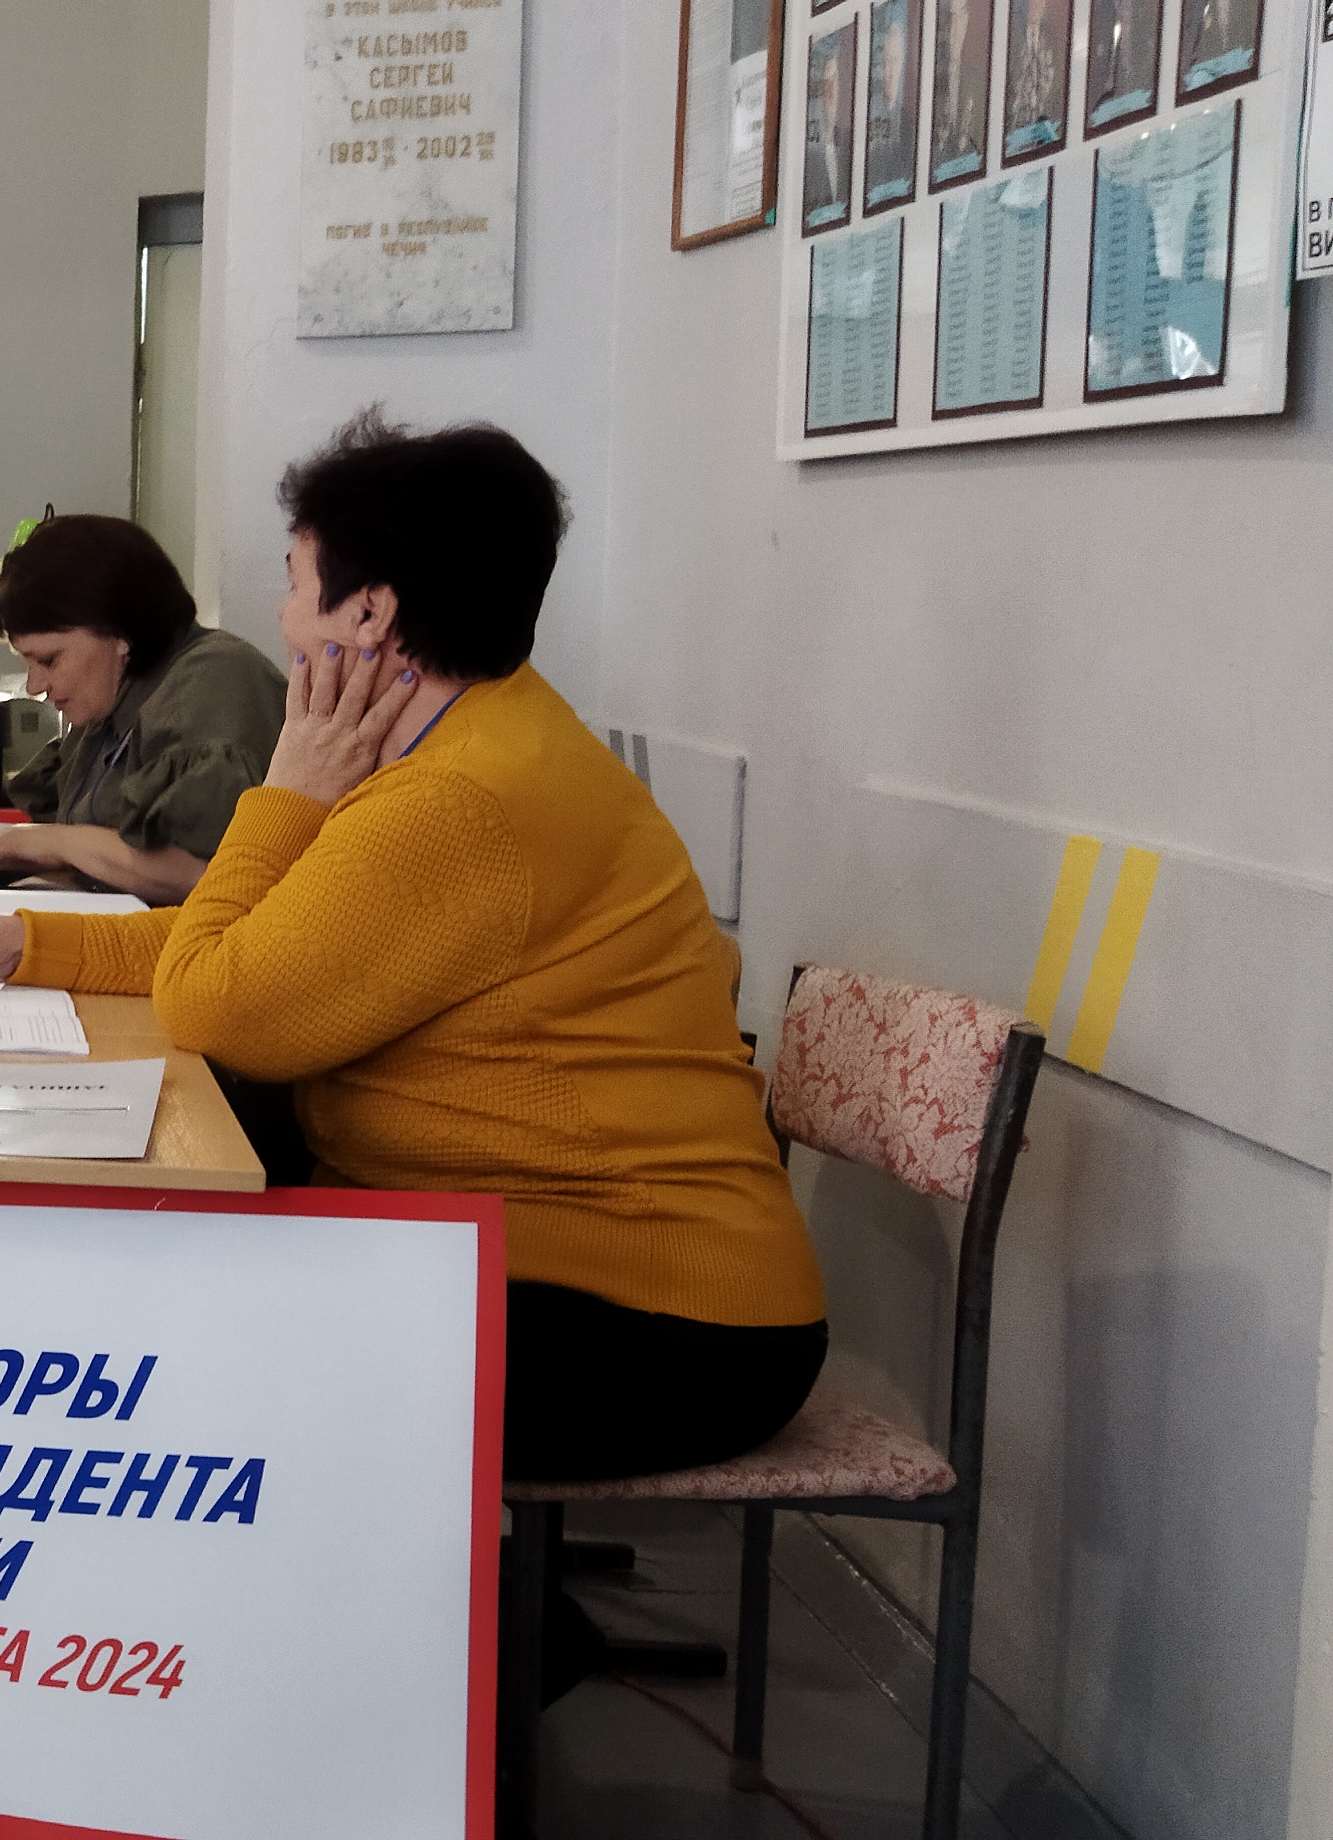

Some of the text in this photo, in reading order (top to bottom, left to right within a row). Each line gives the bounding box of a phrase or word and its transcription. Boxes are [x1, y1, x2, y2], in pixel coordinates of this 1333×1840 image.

[357, 30, 468, 58] КАСЫМОВ
[350, 93, 471, 123] САФИЕВИЧ
[1309, 201, 1321, 223] В
[37, 1634, 185, 1701] 2024
